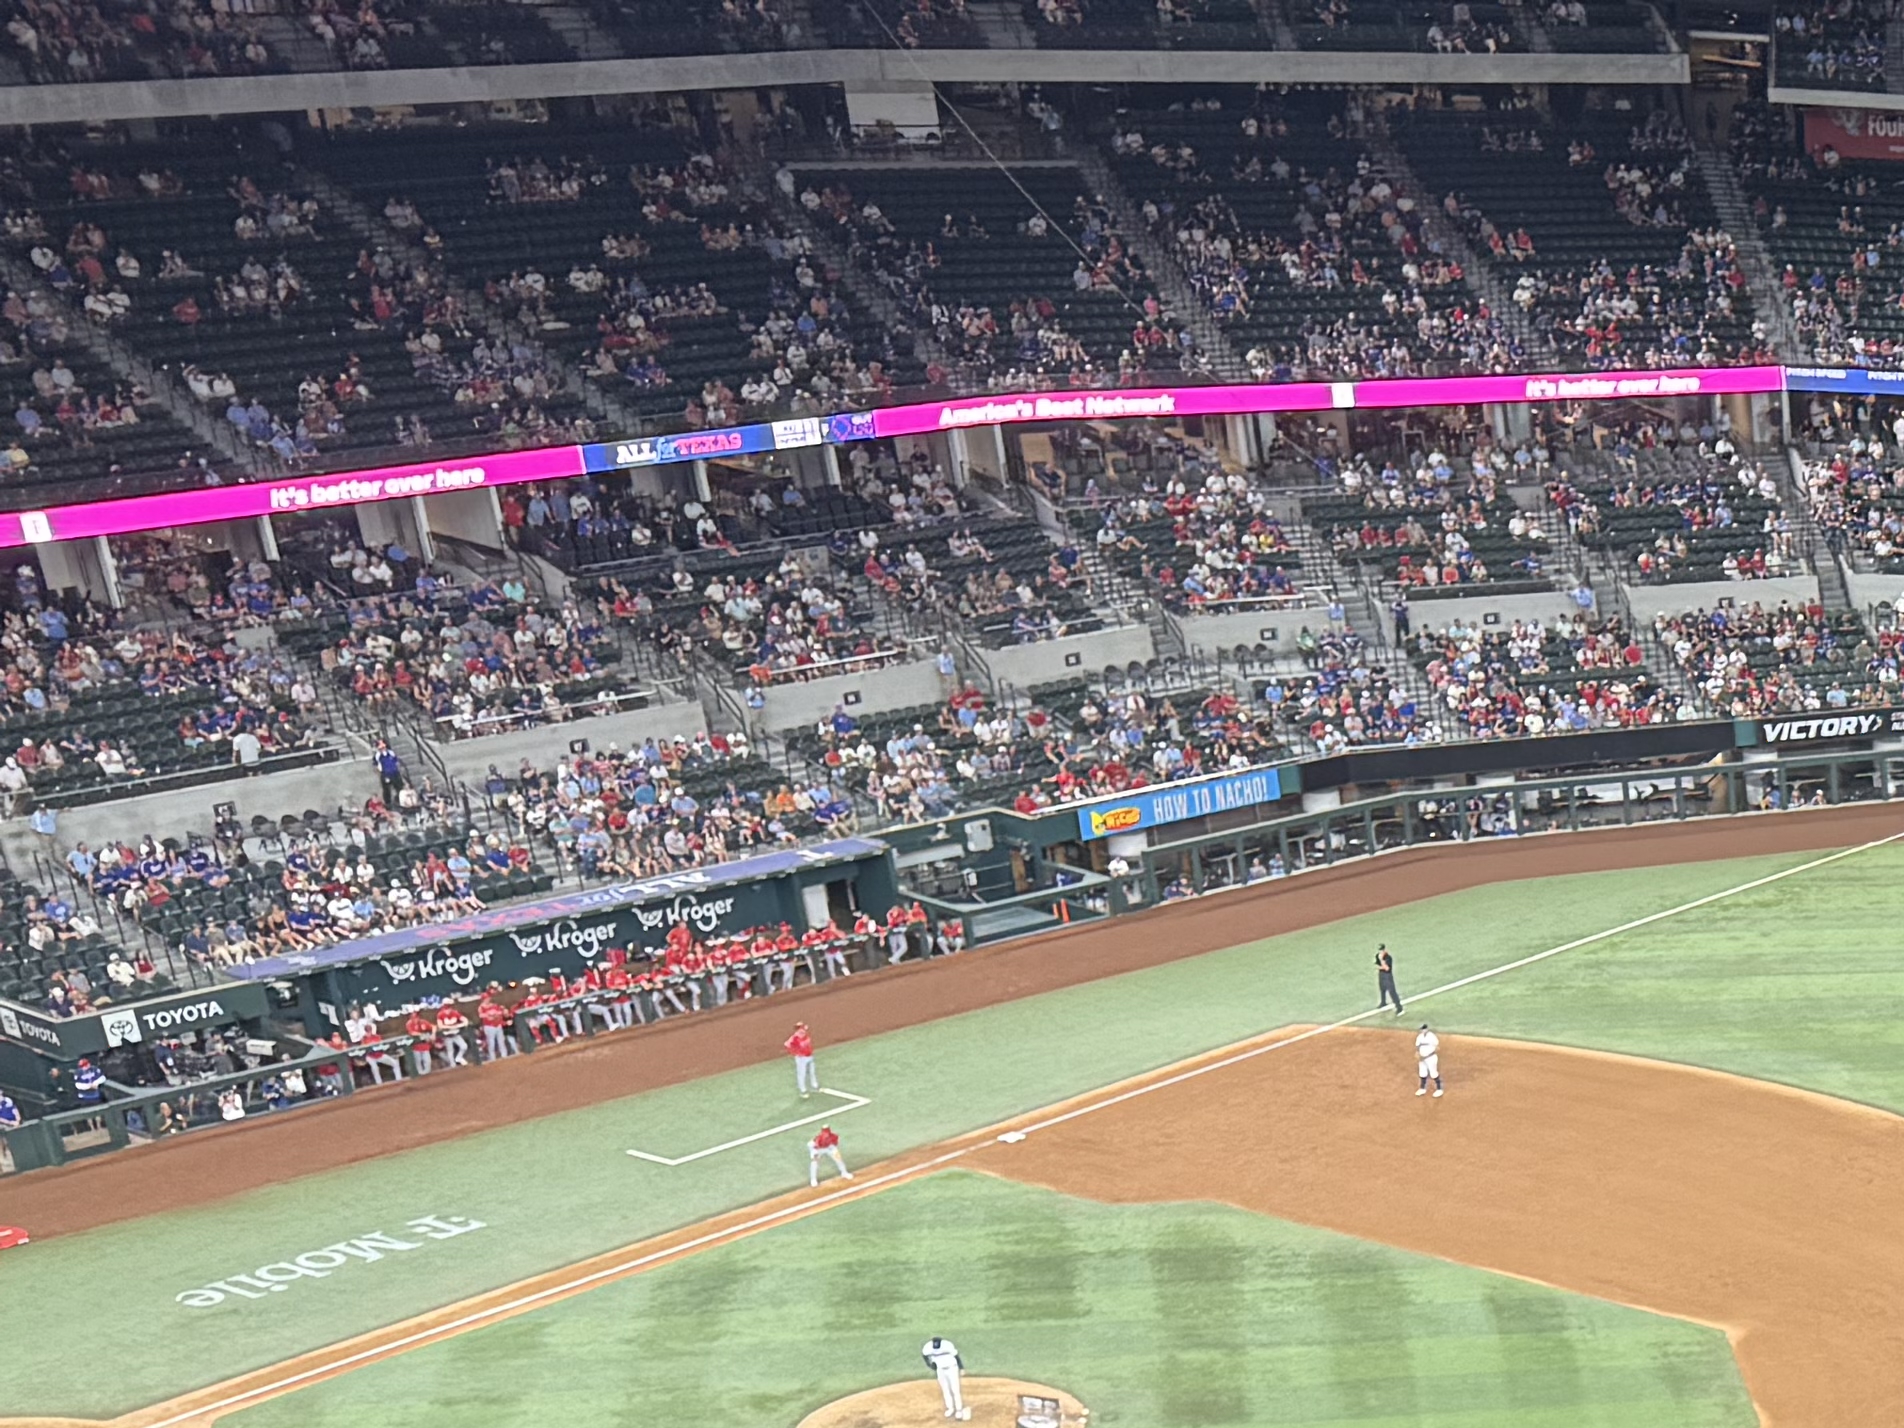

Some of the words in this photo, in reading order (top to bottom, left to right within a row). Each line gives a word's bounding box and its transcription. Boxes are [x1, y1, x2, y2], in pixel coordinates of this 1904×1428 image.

[616, 443, 658, 464] ALL
[675, 433, 743, 455] TEXAS
[270, 486, 309, 508] It's
[310, 480, 383, 503] better
[384, 473, 435, 494] over
[436, 467, 486, 488] here
[1153, 792, 1189, 823] HOW
[1193, 787, 1211, 814] TO
[1215, 776, 1268, 813] NACHO!
[666, 894, 736, 932] Kroger
[545, 919, 618, 958] Kroger
[419, 947, 494, 985] Kroger
[19, 1020, 61, 1046] TOYOTA
[143, 1000, 224, 1032] TOYOTA
